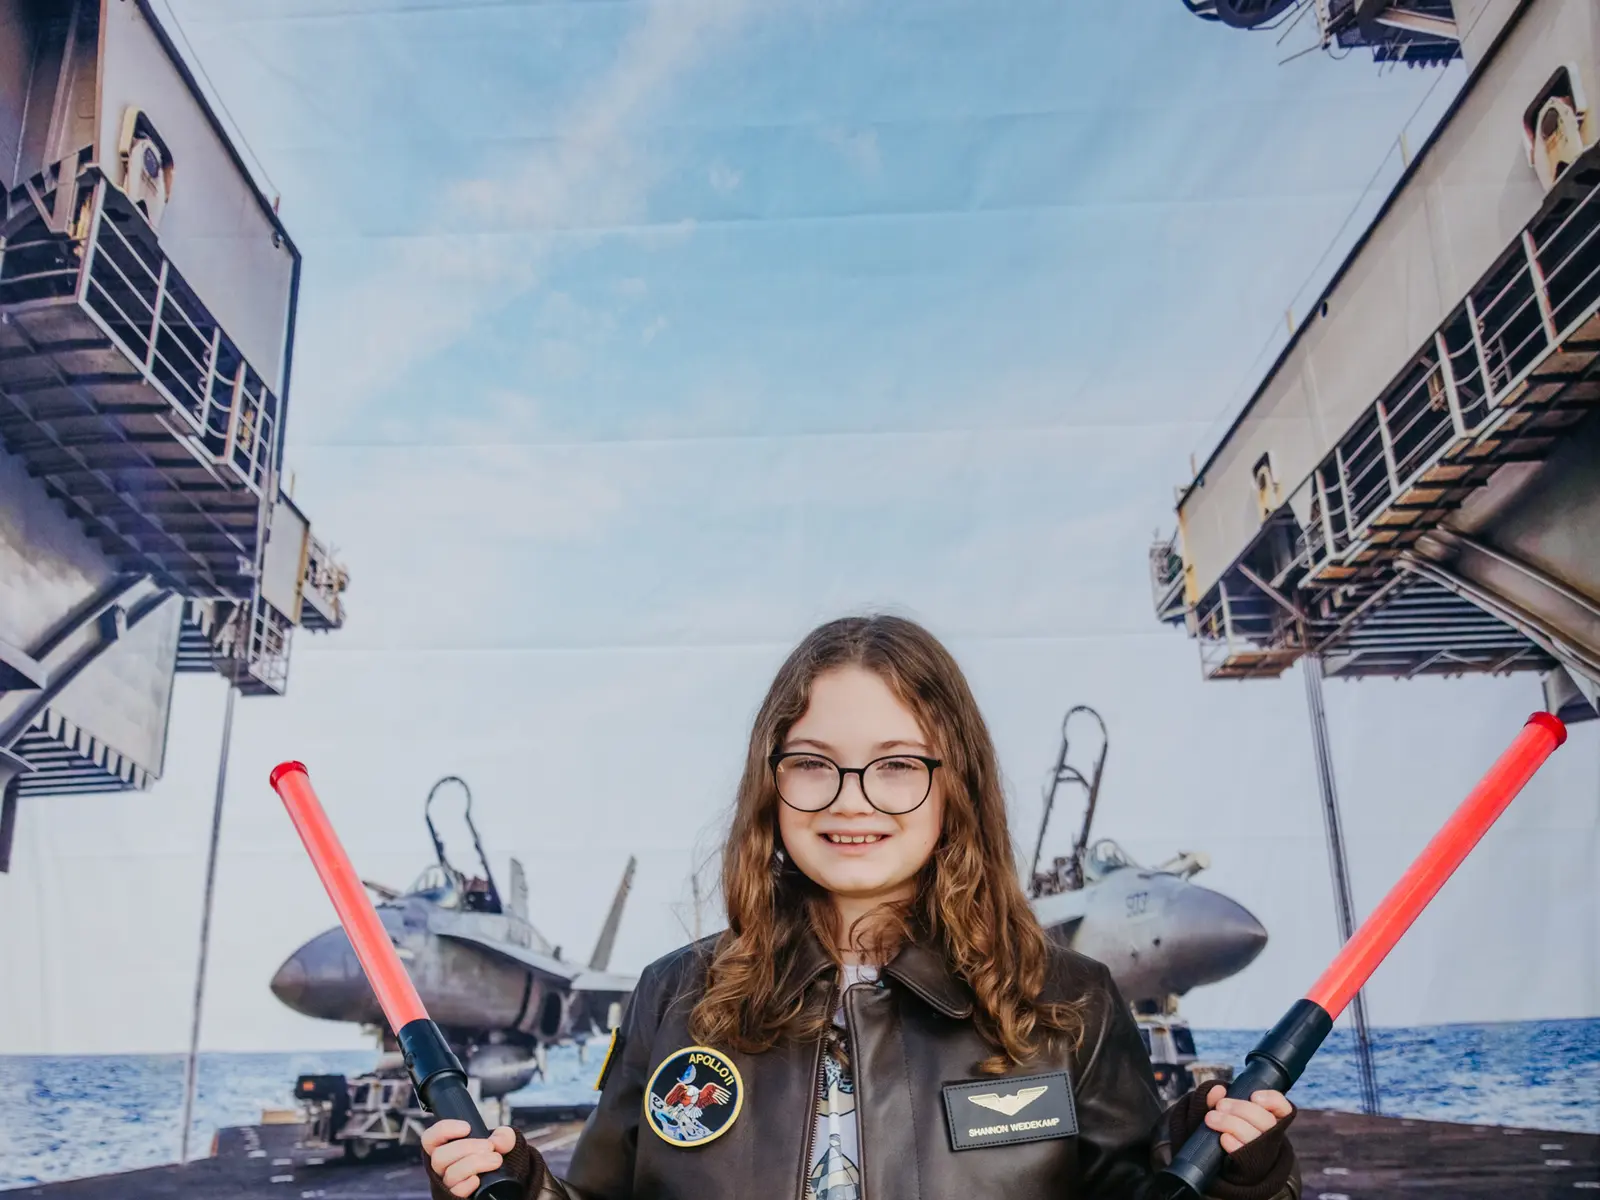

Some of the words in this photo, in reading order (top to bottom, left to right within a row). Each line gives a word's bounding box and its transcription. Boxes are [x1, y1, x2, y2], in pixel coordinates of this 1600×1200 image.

[689, 1053, 729, 1078] APOLLO
[724, 1075, 735, 1086] 11
[969, 1125, 1008, 1137] SHANNON
[1010, 1118, 1060, 1132] WEIDEKAMP
